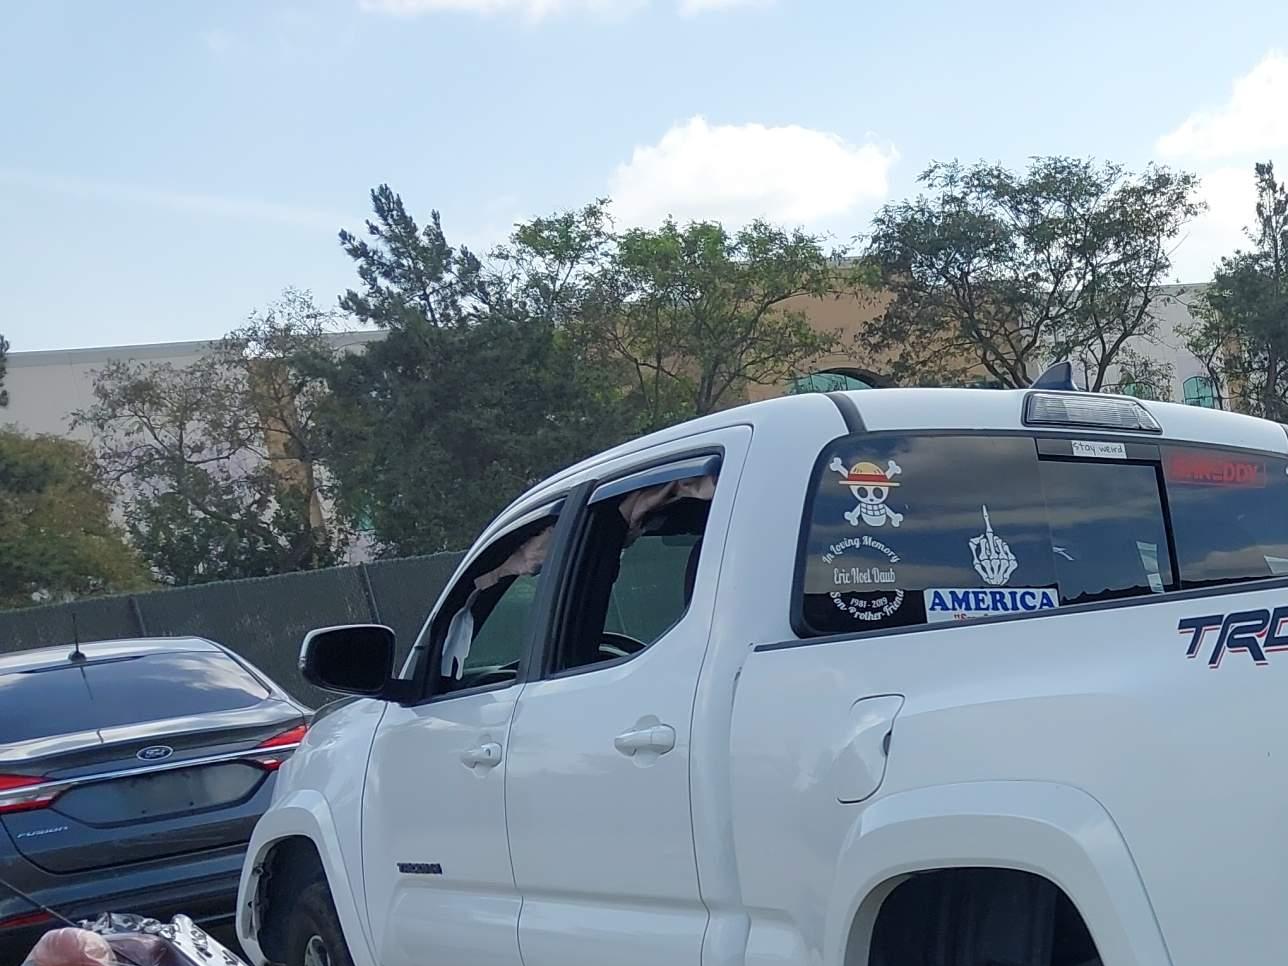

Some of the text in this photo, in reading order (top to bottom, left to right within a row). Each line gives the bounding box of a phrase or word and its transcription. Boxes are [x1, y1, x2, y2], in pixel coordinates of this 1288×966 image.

[1073, 442, 1123, 456] stay weird
[1173, 457, 1258, 483] REDDY
[822, 535, 900, 564] In Loving Memory
[833, 567, 896, 585] Eric Noel Daub
[830, 591, 847, 611] Son
[928, 590, 1055, 612] AMERICA
